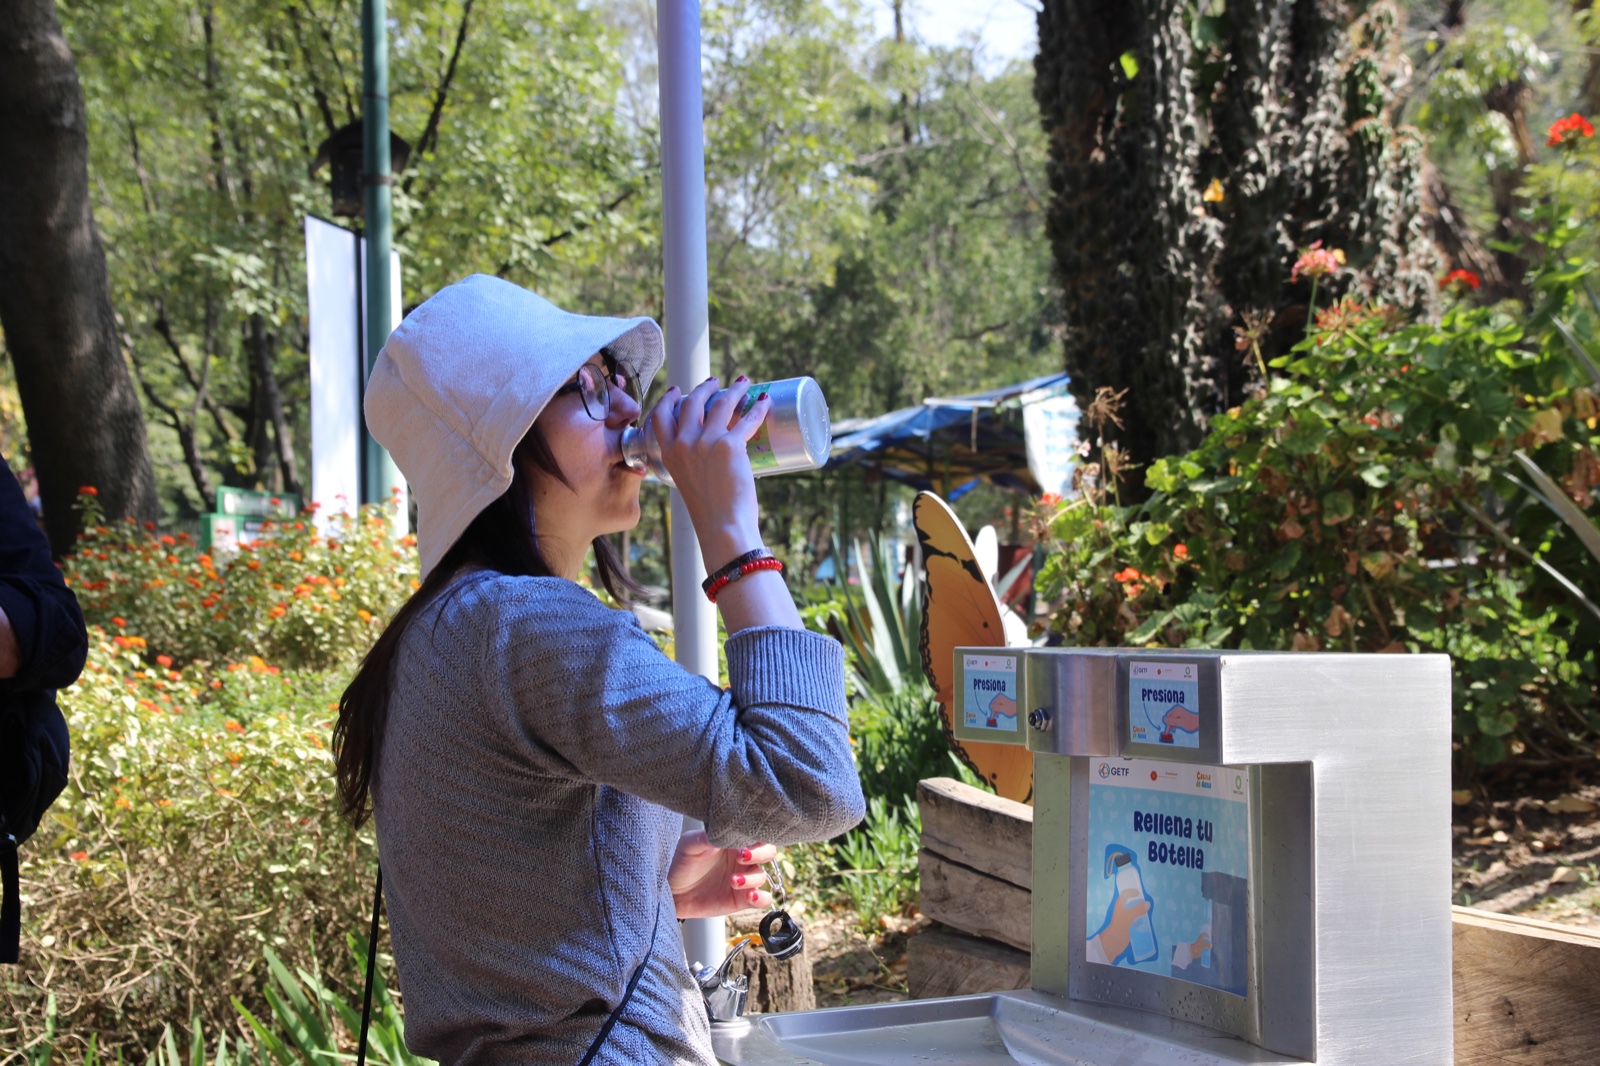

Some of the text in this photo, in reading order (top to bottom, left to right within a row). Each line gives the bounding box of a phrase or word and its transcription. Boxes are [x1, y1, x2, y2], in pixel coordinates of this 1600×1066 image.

[973, 678, 1006, 692] Presiona
[1142, 687, 1185, 704] Presiona
[1111, 767, 1130, 777] GETF
[1133, 810, 1214, 843] Rellena tu
